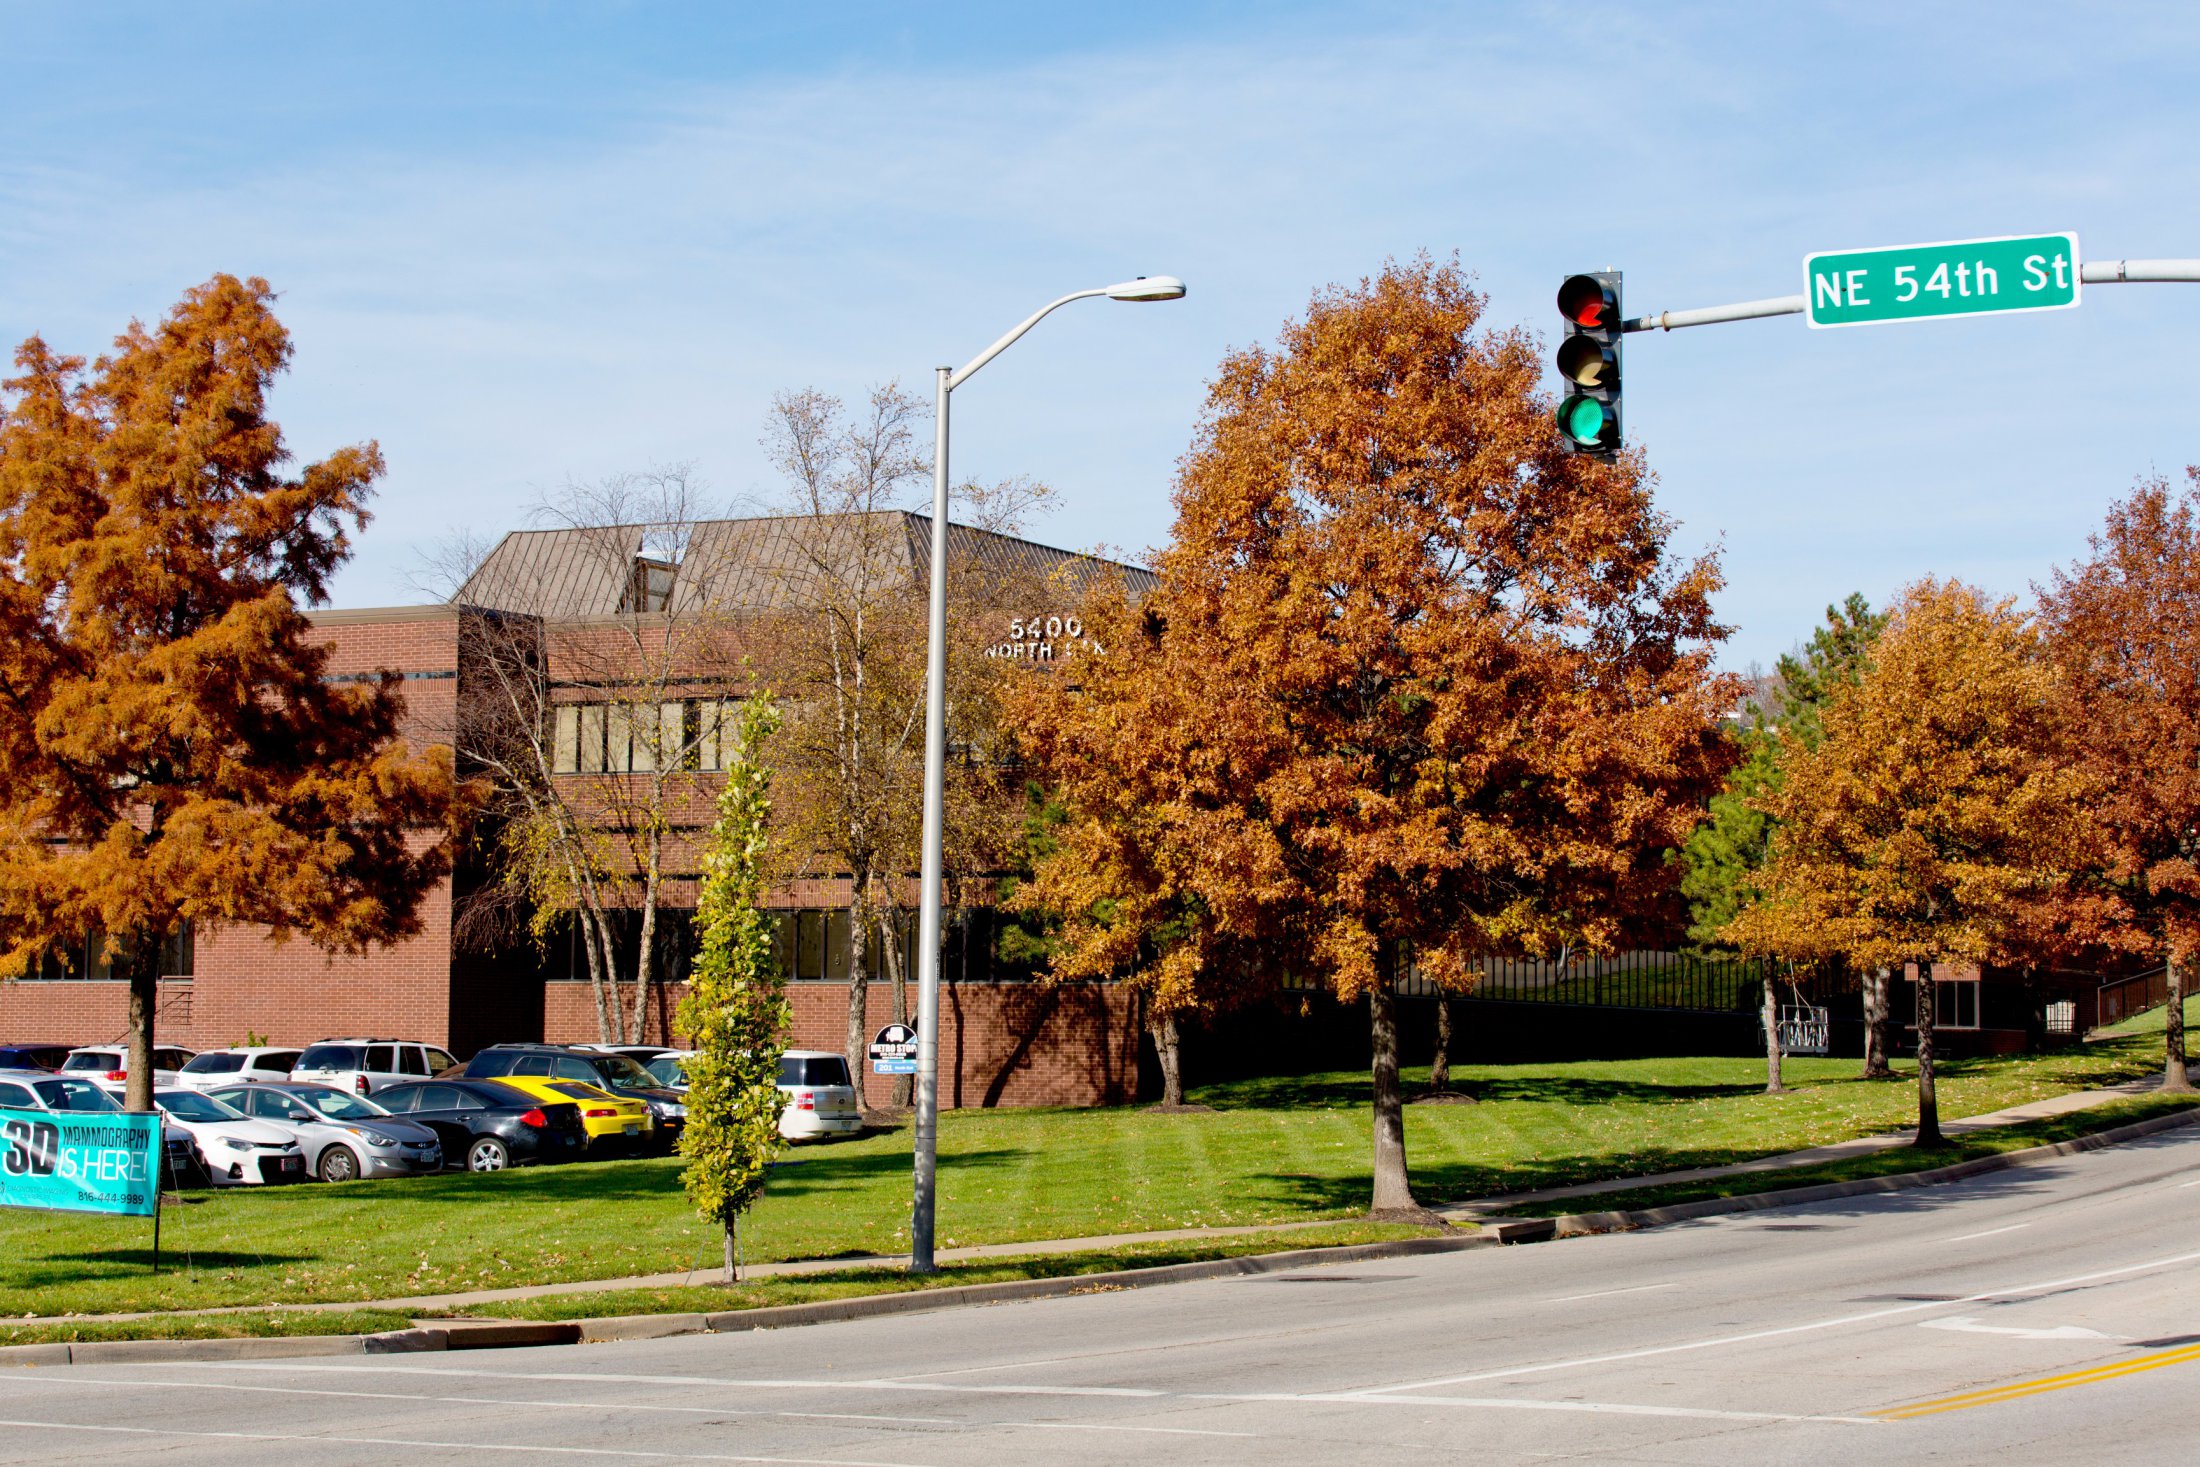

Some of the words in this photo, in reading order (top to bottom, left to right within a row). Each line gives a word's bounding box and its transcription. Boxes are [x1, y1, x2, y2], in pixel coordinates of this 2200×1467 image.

[1815, 269, 1870, 309] NE
[1894, 260, 1998, 302] 54th
[2022, 253, 2069, 292] St
[1010, 616, 1082, 640] 5400
[985, 641, 1052, 658] NORTH
[870, 1044, 895, 1053] METRO
[896, 1044, 916, 1053] STOP
[1, 1119, 59, 1177] 3D
[62, 1126, 151, 1149] MAMMOGRAPHY
[57, 1148, 77, 1178] IS
[82, 1149, 148, 1182] HERE!
[78, 1191, 144, 1205] 816-444-9989
